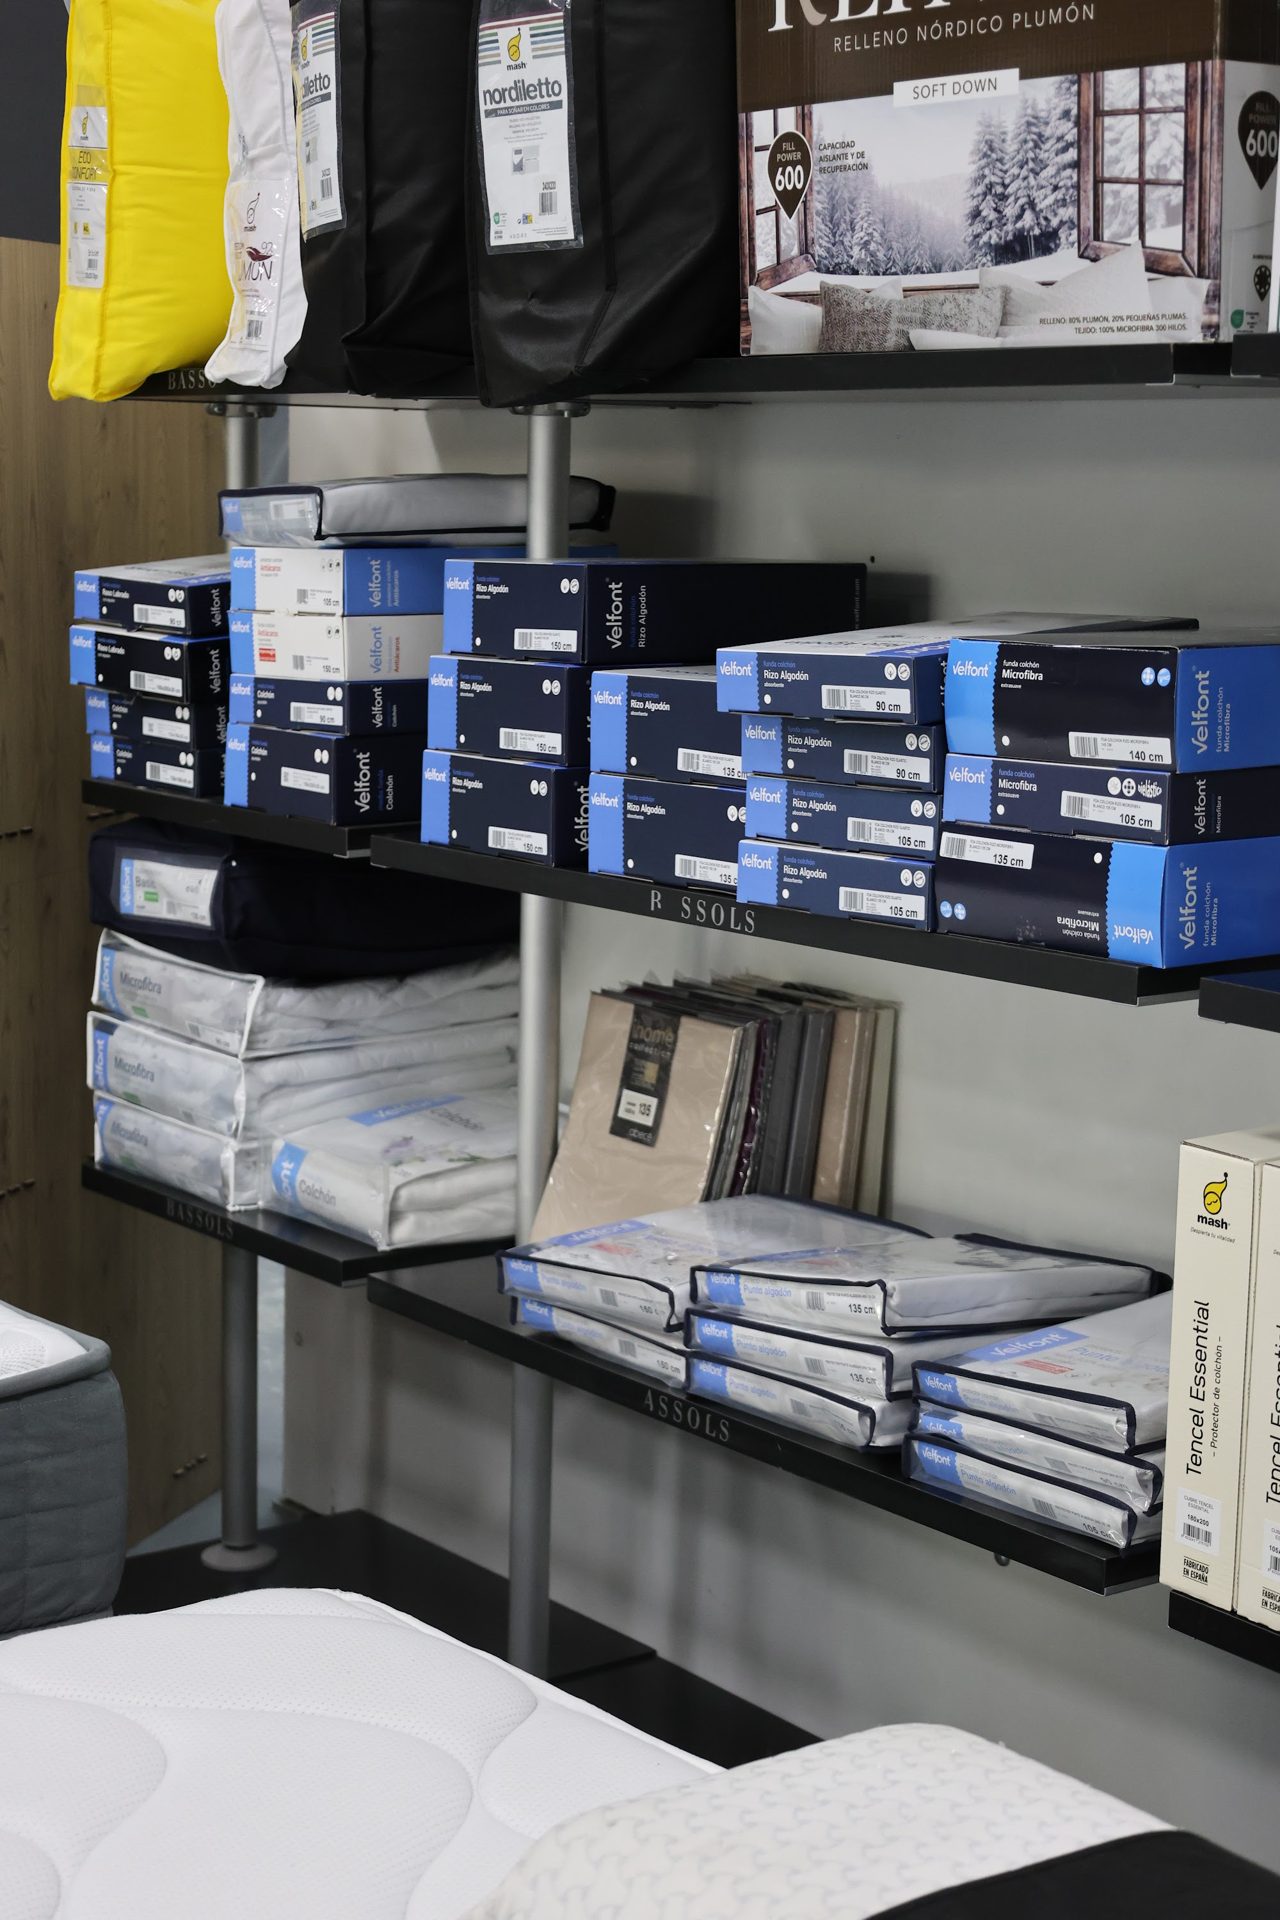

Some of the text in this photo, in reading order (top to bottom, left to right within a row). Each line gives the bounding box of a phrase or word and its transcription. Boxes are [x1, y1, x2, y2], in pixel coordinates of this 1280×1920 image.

[834, 28, 907, 53] RELLENO
[916, 15, 1001, 41] NÓRDICO
[1012, 3, 1095, 30] PLUMÓN
[506, 61, 526, 71] mash
[482, 77, 562, 106] nordiletto
[913, 77, 998, 100] SOFT DOWN
[782, 142, 796, 151] FILL
[818, 140, 856, 151] CAPACIDAD
[1246, 129, 1277, 158] 600
[776, 152, 802, 162] POWER
[818, 151, 866, 163] AISLANTE Y DE
[818, 162, 869, 174] RECUPERACIÓN
[775, 164, 804, 192] 600
[1039, 317, 1066, 325] RELLENO:
[1082, 314, 1110, 324] PLUMÓN,
[1126, 313, 1160, 322] PEQUEÑAS
[1160, 312, 1188, 320] PLUMAS.
[1074, 323, 1188, 335] TEJIDO: 100% MICROFIBRA 300 HILOS.
[368, 558, 382, 608] Velfont
[446, 578, 470, 590] Velfont
[476, 584, 509, 595] Rizo Algodón
[210, 588, 220, 628] Velfont
[606, 582, 624, 649] Velfont
[638, 585, 648, 648] Rizo Algodón
[369, 626, 382, 674] Velfont
[550, 641, 562, 650] 150
[208, 648, 220, 694] Velfont
[720, 661, 752, 676] Velfont
[952, 660, 989, 678] Velfont
[1002, 660, 1040, 669] funda colchón
[430, 673, 454, 688] Velfont
[764, 670, 809, 682] Rizo Algodón
[1002, 668, 1044, 682] Microfibra
[460, 680, 493, 693] Rizo Algodón
[594, 690, 622, 706] Velfont
[630, 699, 670, 712] Rizo Algodón
[1216, 686, 1224, 723] colchón
[372, 686, 383, 728] Velfont
[876, 701, 902, 712] 90 cm
[1190, 670, 1210, 754] Velfont
[744, 724, 776, 742] Velfont
[788, 734, 832, 748] Rizo Algodón
[536, 743, 546, 752] 150
[1129, 750, 1164, 762] 140 cm
[424, 768, 447, 783] Velfont
[722, 766, 736, 776] 135
[896, 768, 921, 781] 90 cm
[949, 766, 985, 785] Velfont
[998, 769, 1035, 779] funda colchón
[354, 751, 371, 813] Velfont
[463, 778, 484, 790] Algodón
[998, 778, 1038, 792] Microfibra
[386, 774, 394, 810] Colchón
[591, 792, 619, 808] Velfont
[750, 786, 781, 804] Velfont
[626, 802, 666, 816] Rizo Algodón
[792, 798, 837, 812] Rizo Algodón
[1194, 778, 1206, 834] Velfont
[574, 785, 589, 852] Velfont
[1119, 814, 1152, 828] 105 cm
[524, 842, 544, 854] 150 cm
[898, 836, 926, 848] 105 cm
[740, 853, 773, 871] Velfont
[992, 852, 1024, 868] 135 cm
[720, 873, 732, 884] 135
[783, 864, 828, 880] Rizo Algodón
[888, 906, 918, 918] 105 cm
[1178, 866, 1198, 950] Velfont
[1202, 882, 1212, 946] funda colchón
[1056, 916, 1100, 932] Microfibra
[1062, 928, 1100, 941] funda colchón
[1114, 924, 1154, 945] Velfont
[120, 970, 162, 994] Microfibra
[114, 1056, 155, 1082] Microfibra
[300, 1179, 337, 1207] Colchón
[167, 1198, 234, 1239] BASSOLS
[1197, 1214, 1228, 1230] mash
[848, 1303, 862, 1314] 135
[702, 1322, 728, 1339] Velfont
[990, 1332, 1070, 1358] Velfont
[850, 1372, 864, 1384] 135
[925, 1374, 952, 1392] Velfont
[1186, 1300, 1210, 1476] Tencel Essential
[1210, 1342, 1224, 1449] Protector de colchón
[922, 1448, 952, 1467] Velfont
[1183, 1557, 1209, 1574] FABRICADO
[1182, 1566, 1209, 1584] EN ESPAÑA
[1262, 1598, 1268, 1608] EN
